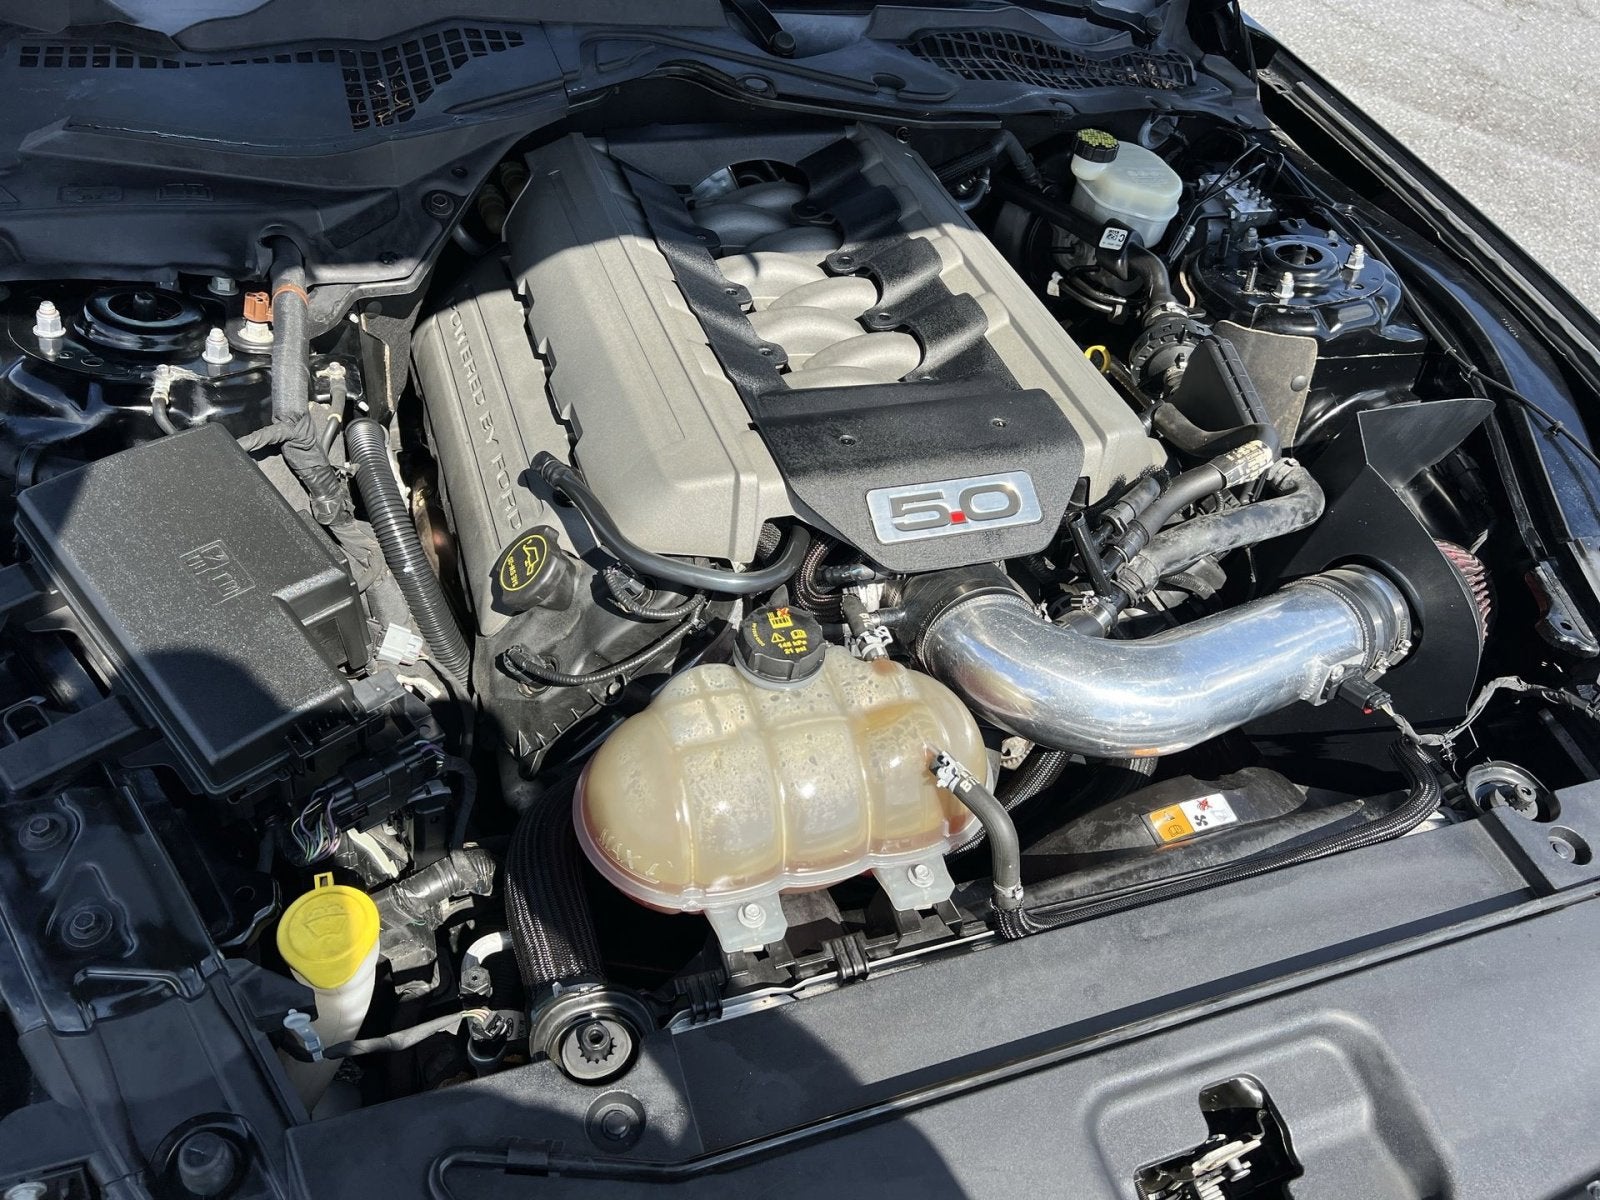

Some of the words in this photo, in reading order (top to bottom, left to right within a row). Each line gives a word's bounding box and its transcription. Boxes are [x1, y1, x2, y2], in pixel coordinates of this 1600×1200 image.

[446, 296, 486, 406] POWERED
[479, 410, 500, 444] BY
[491, 452, 523, 530] FORD
[889, 482, 1022, 532] 5.0
